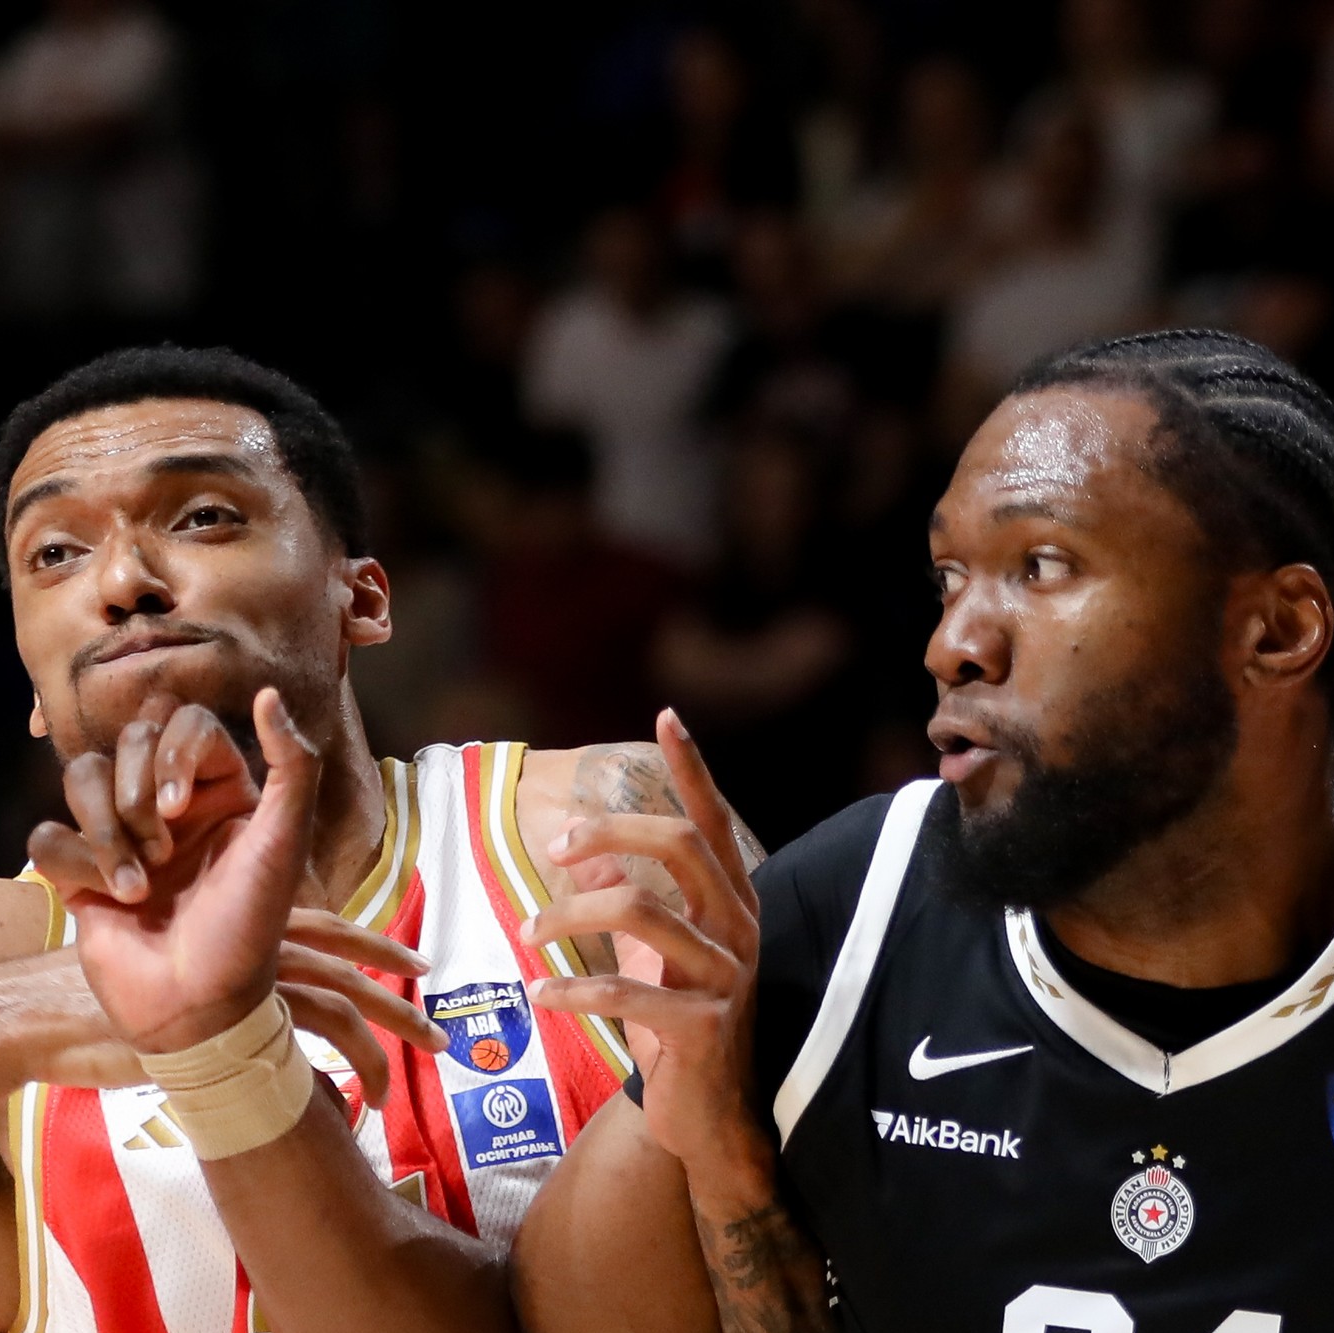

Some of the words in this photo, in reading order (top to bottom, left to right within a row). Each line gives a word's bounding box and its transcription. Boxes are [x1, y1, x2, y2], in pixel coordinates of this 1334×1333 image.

[435, 986, 522, 1011] ADMIRAL
[492, 997, 522, 1010] BET
[466, 1012, 503, 1038] ABA
[492, 1130, 537, 1148] ДУНАВ
[889, 1114, 1022, 1160] AikBank
[475, 1141, 558, 1164] ОСИГУРАЊЕ
[1115, 1180, 1142, 1246] PARTIZAN
